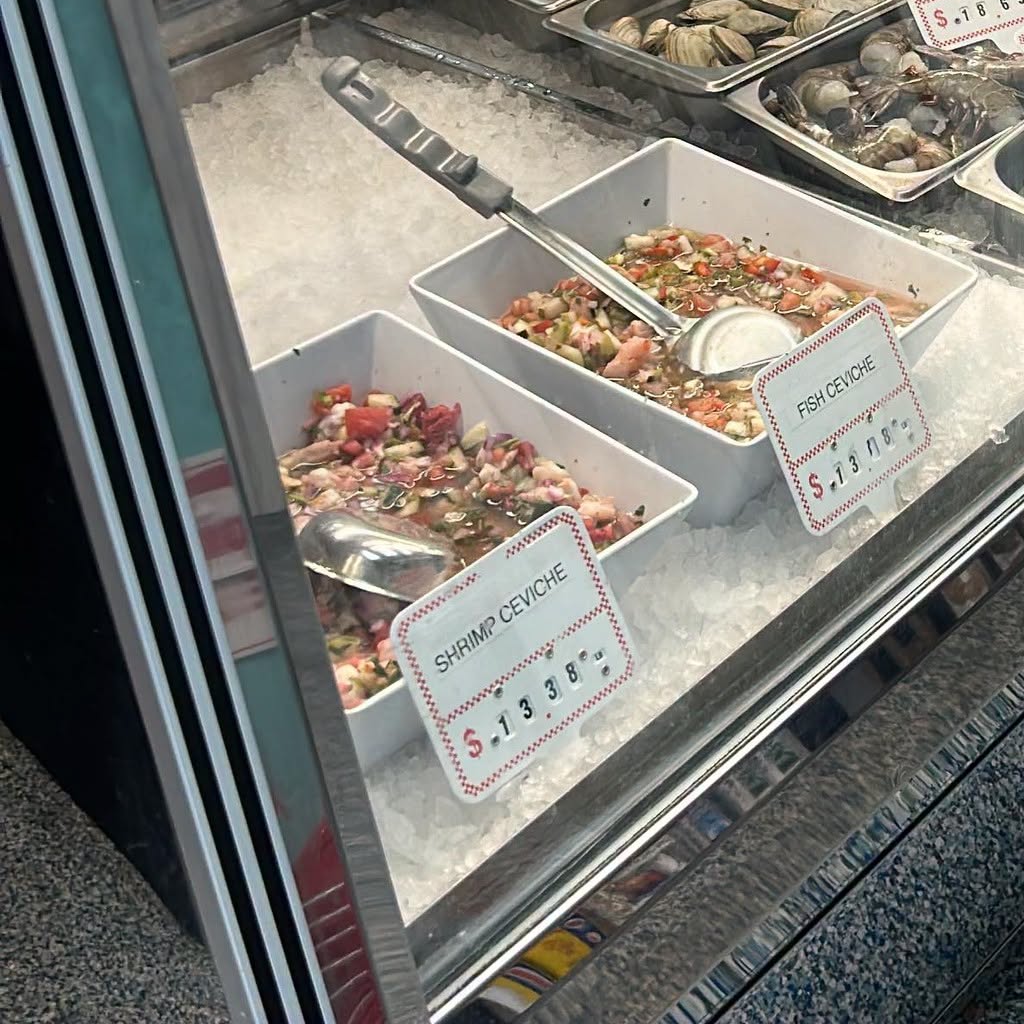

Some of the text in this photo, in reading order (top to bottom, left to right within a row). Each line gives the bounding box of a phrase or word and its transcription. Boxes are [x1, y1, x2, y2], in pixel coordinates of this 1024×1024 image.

[797, 354, 876, 419] FISH CEVICHE
[434, 562, 569, 674] SHRIMP CEVICHE
